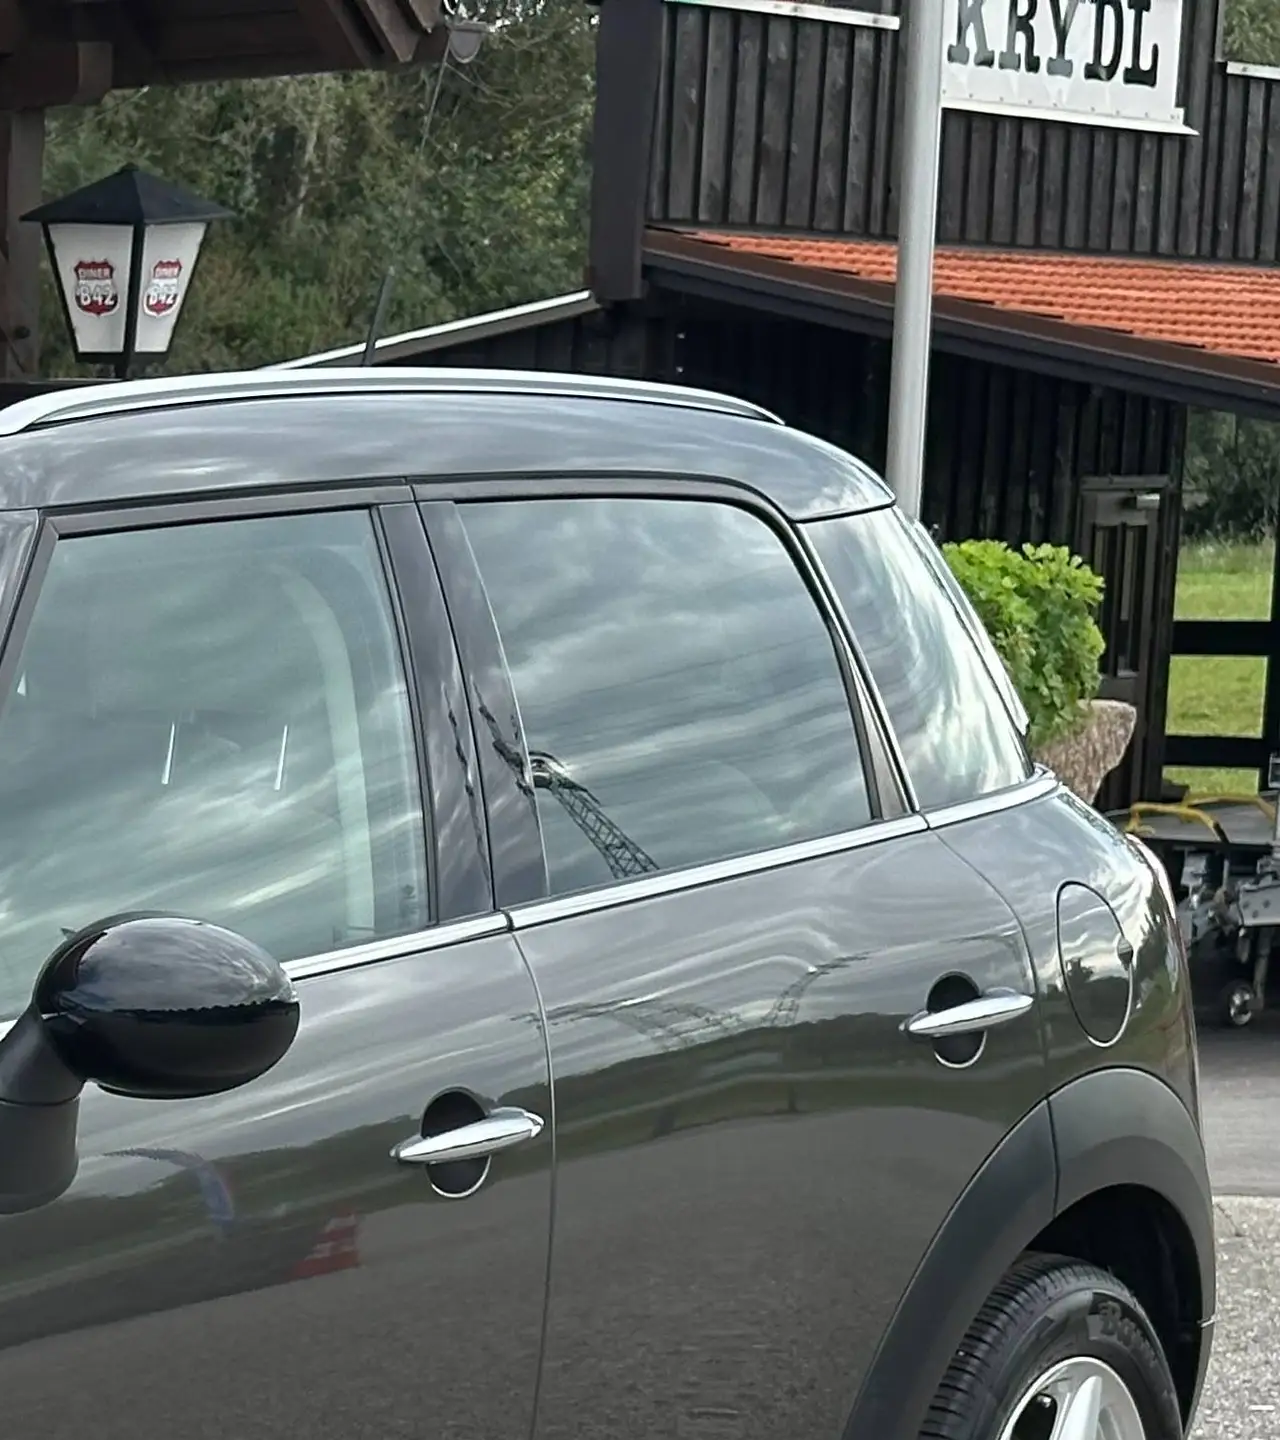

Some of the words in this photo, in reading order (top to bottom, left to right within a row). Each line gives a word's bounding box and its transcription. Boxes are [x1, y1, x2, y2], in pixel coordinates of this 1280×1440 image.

[947, 0, 1159, 87] KRYDL
[78, 268, 110, 279] DINER
[78, 284, 115, 306] B42
